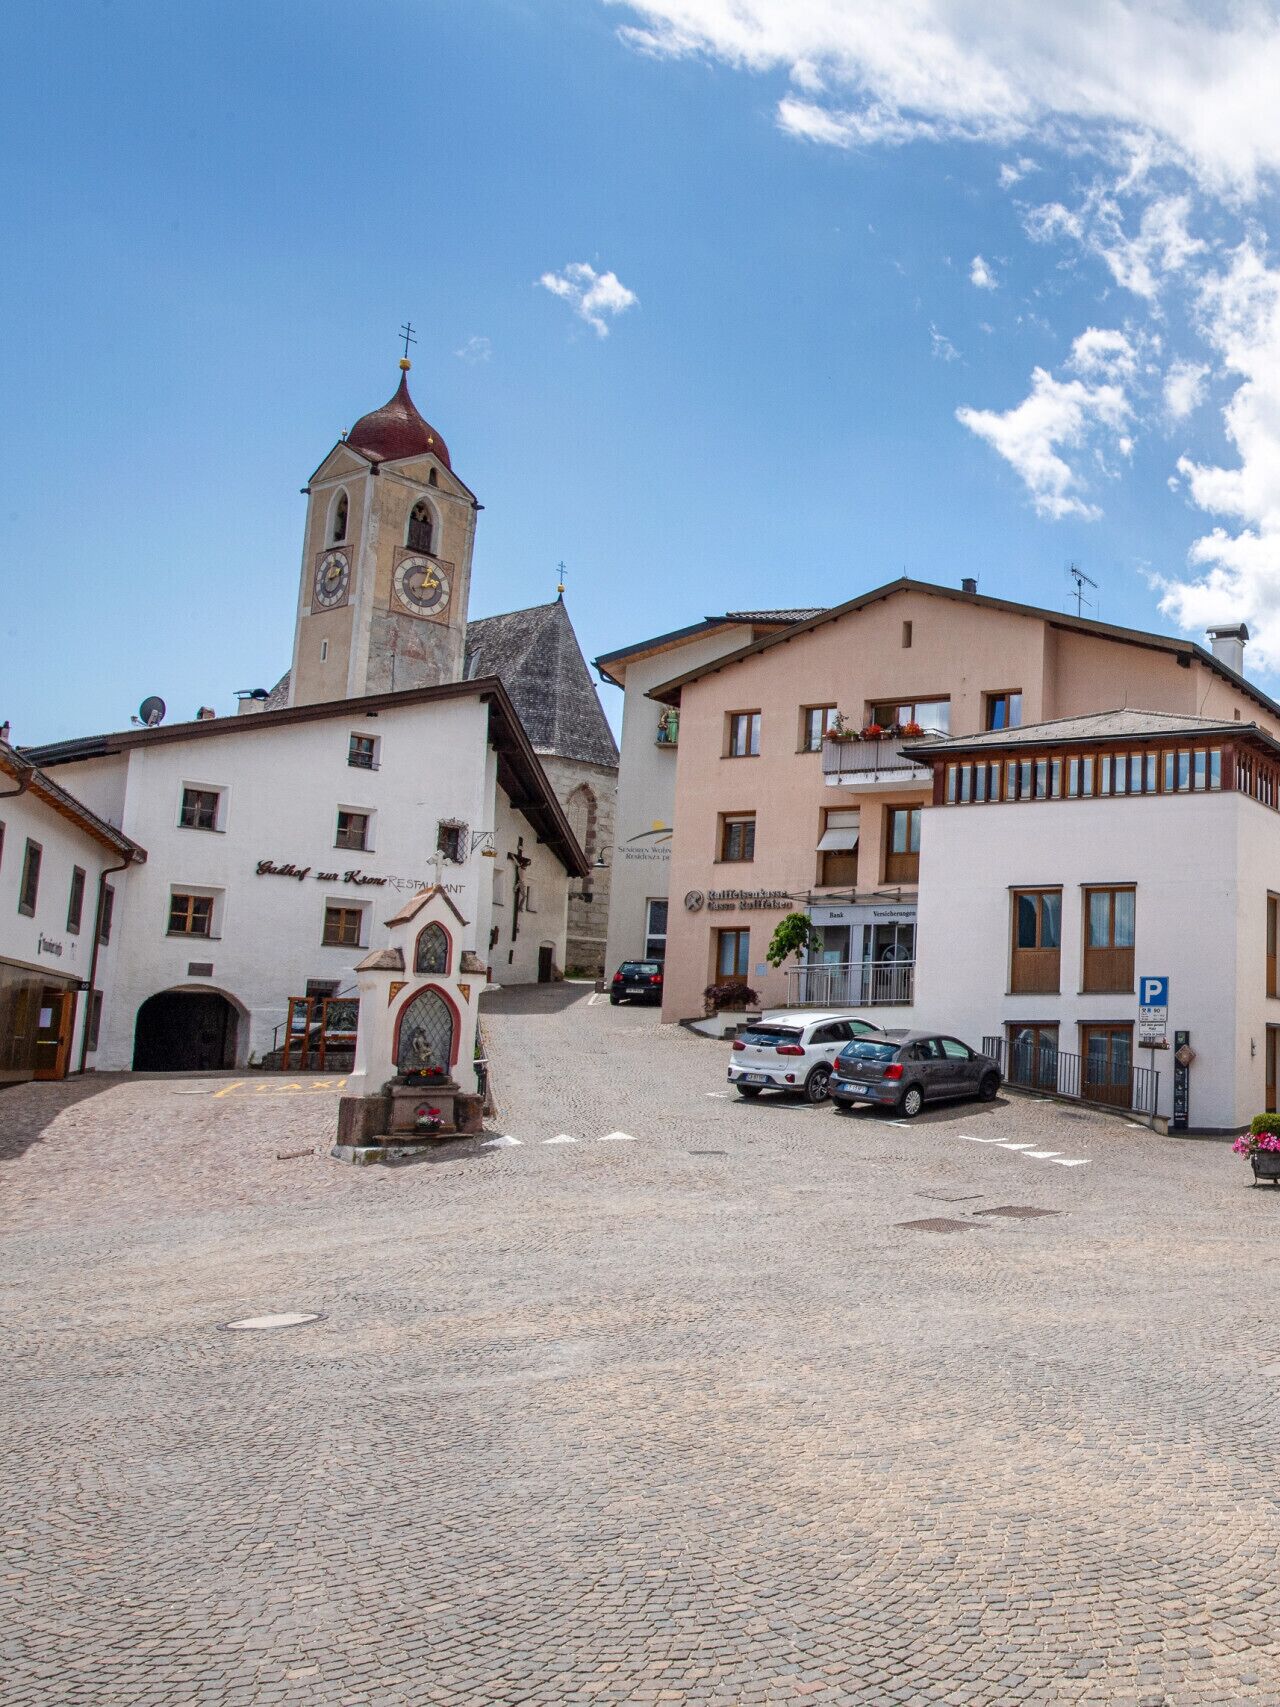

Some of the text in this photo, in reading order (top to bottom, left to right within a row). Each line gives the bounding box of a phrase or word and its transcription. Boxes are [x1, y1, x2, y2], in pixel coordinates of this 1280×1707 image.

[316, 870, 339, 881] zur
[343, 869, 388, 886] Krone
[1145, 979, 1163, 1004] P
[255, 1079, 347, 1091] TAXI
